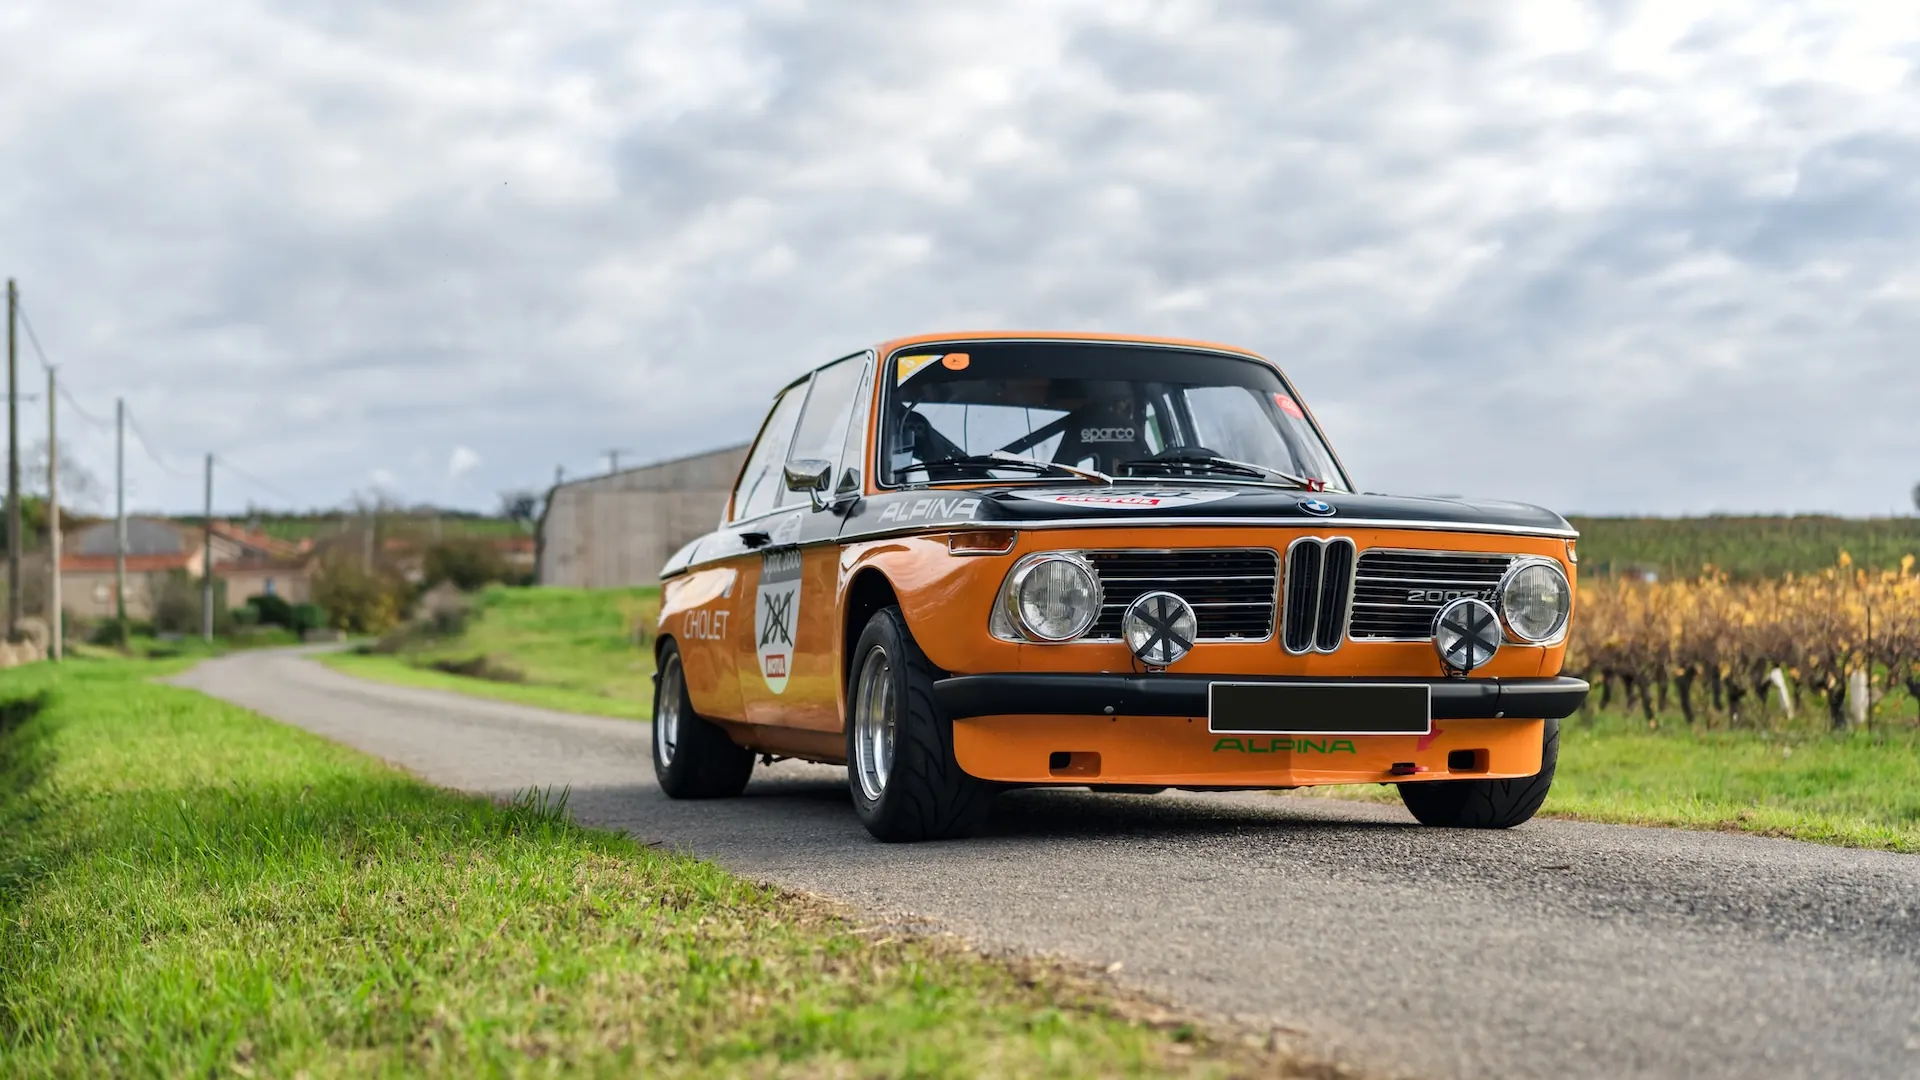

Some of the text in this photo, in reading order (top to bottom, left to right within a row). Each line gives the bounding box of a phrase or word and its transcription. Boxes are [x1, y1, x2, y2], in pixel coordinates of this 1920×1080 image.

[877, 498, 982, 523] ALPINA
[683, 610, 730, 640] CHOLET
[1213, 738, 1357, 754] ALPINA
